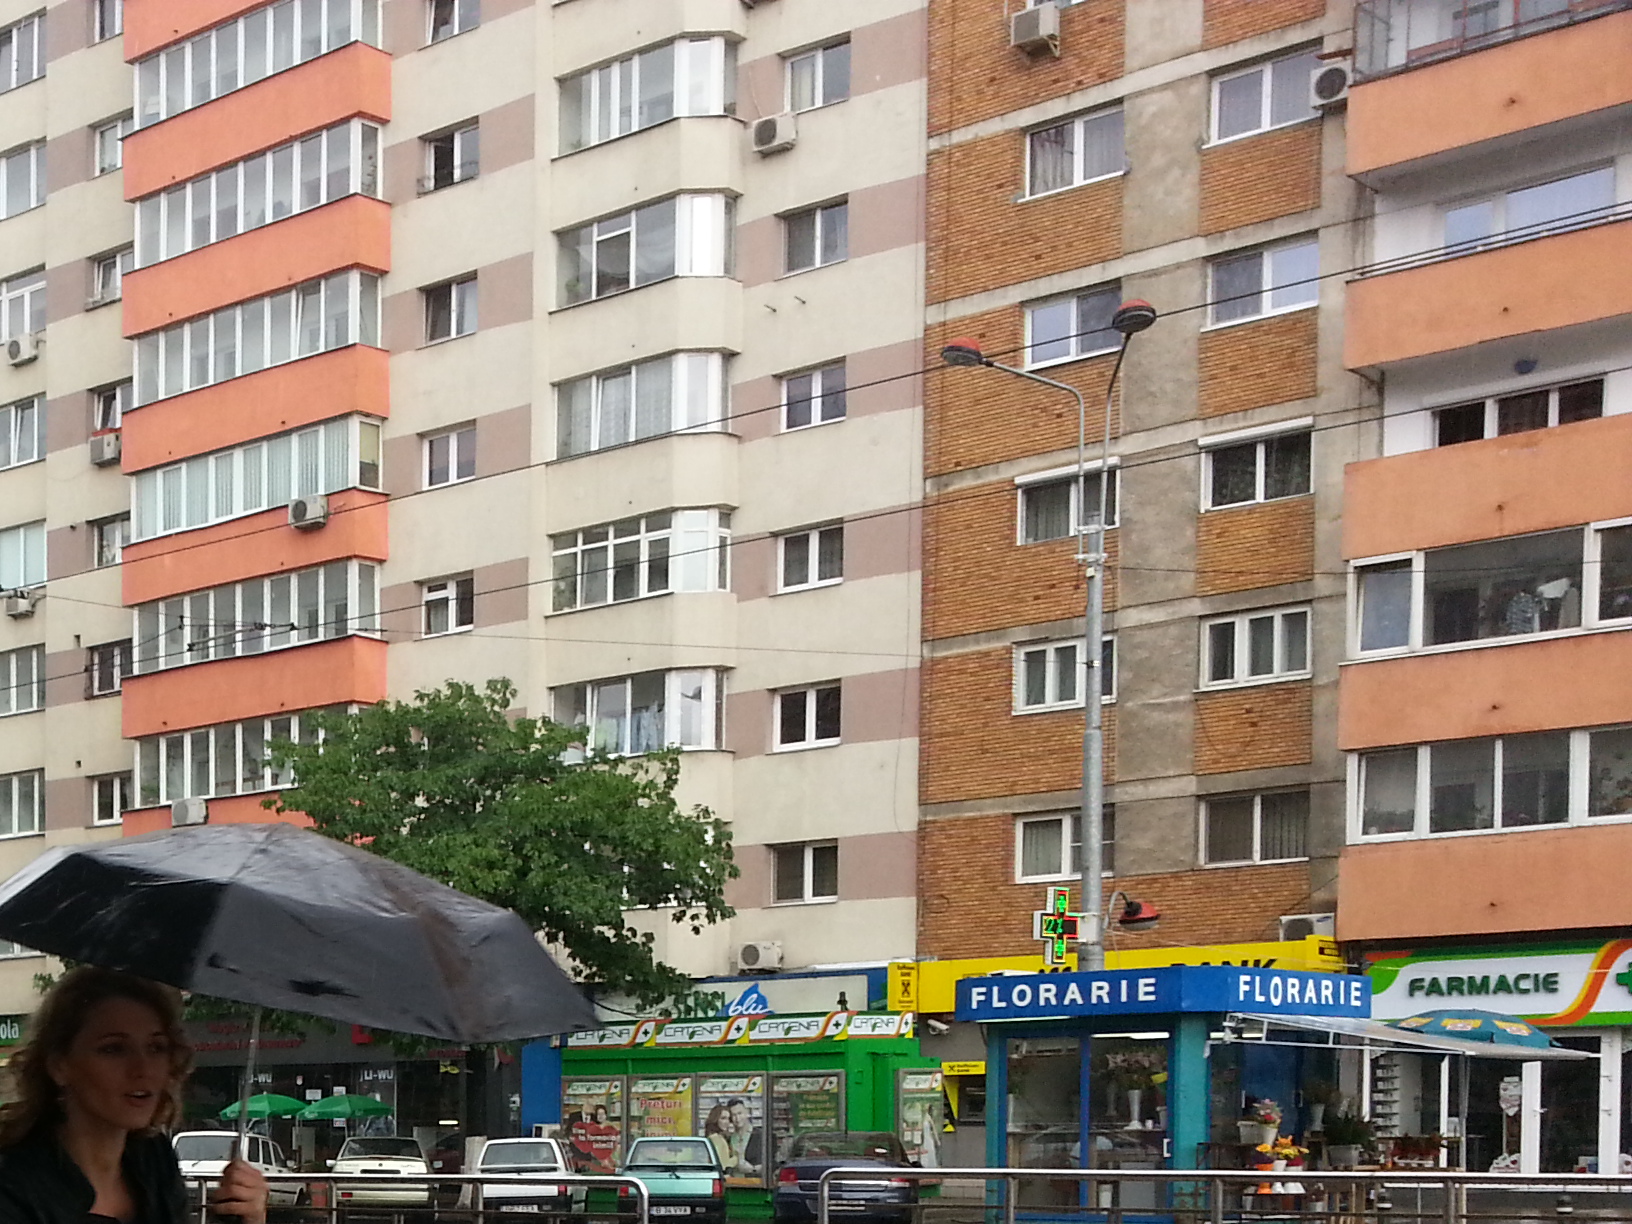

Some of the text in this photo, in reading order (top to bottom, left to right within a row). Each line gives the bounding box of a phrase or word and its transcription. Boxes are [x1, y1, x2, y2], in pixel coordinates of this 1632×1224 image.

[971, 977, 1157, 1009] FLORARIE
[1239, 975, 1362, 1007] FLORARIE
[1408, 972, 1559, 997] FARMACIE
[728, 993, 770, 1015] blu
[664, 1024, 722, 1039] CATENA
[758, 1020, 820, 1035] CATENA
[853, 1018, 895, 1031] CATENA
[575, 1028, 631, 1042] CATENA
